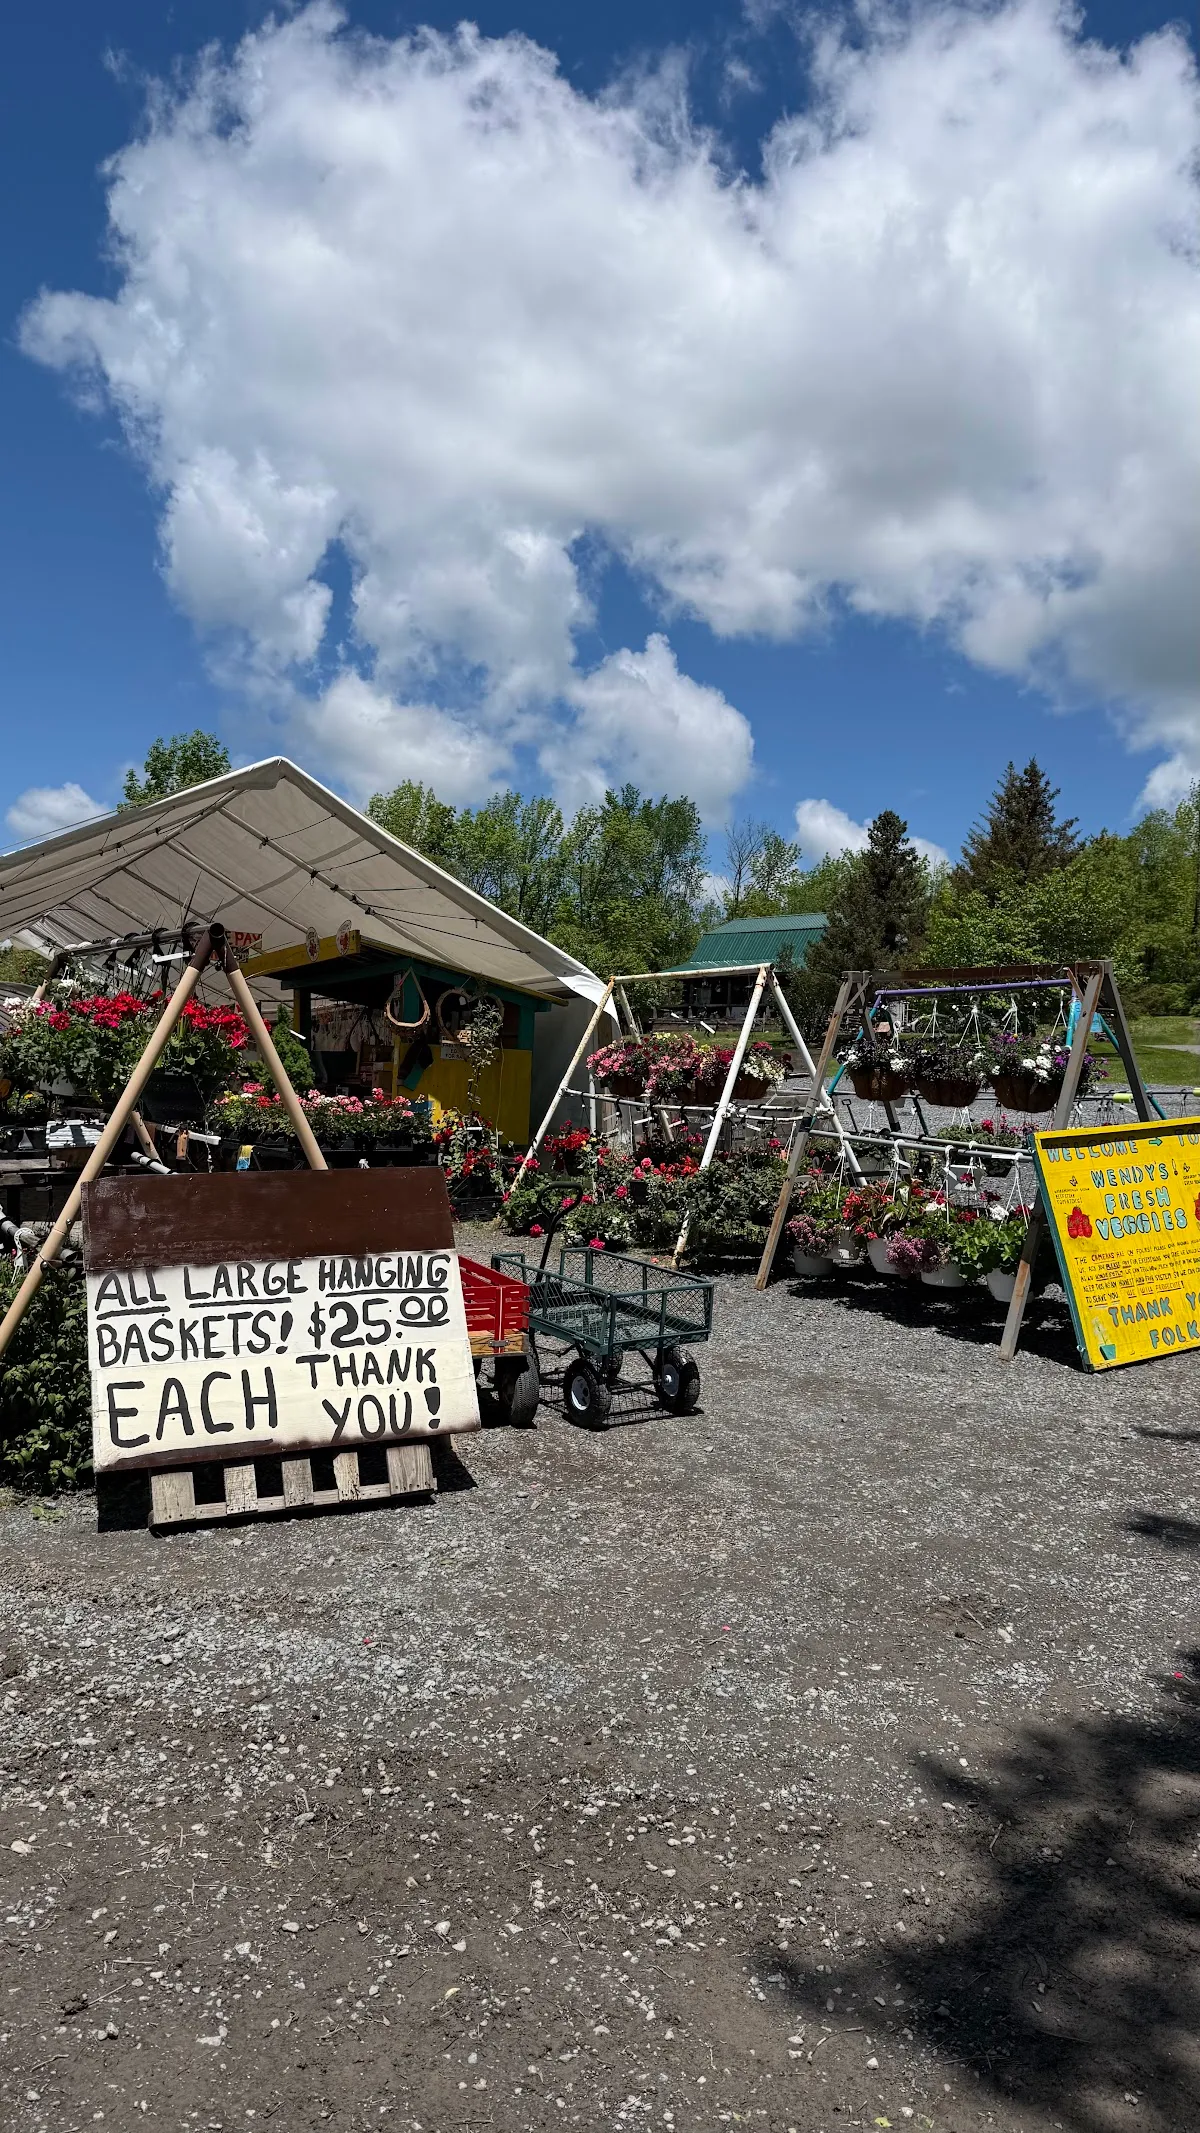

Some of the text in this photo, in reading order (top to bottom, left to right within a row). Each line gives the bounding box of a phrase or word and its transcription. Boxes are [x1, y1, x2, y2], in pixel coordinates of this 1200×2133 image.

[235, 932, 262, 946] PAY
[1046, 1128, 1200, 1163] WELCOME TO
[1105, 1186, 1171, 1215] FRESH
[1095, 1208, 1188, 1240] VEGGIES
[1074, 1256, 1087, 1265] THE
[1091, 1252, 1115, 1262] CAMERAS
[1155, 1272, 1171, 1281] SYSTEM
[95, 1254, 450, 1311] ALL LARGE HANGING
[1108, 1291, 1200, 1328] THANK Y
[96, 1310, 293, 1368] BASKETS!
[295, 1347, 437, 1389] THANK
[106, 1366, 278, 1448] EACH
[321, 1386, 441, 1442] YOU!
